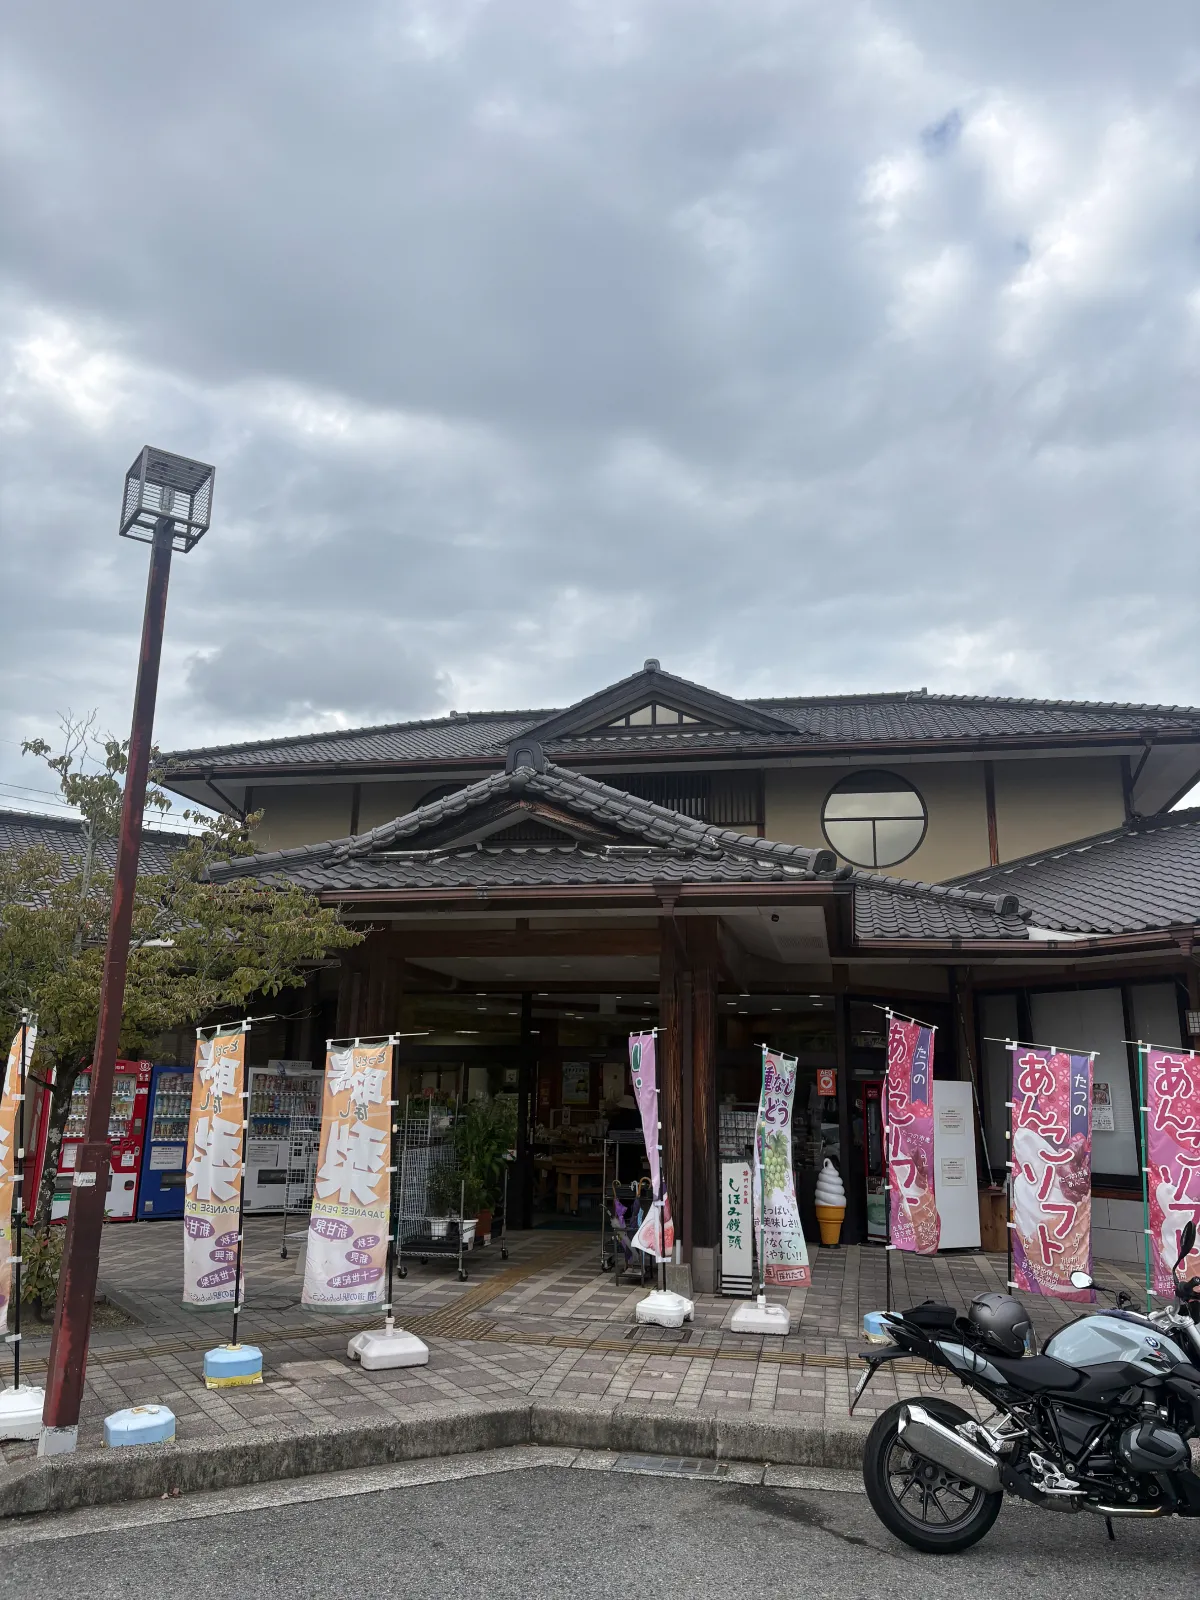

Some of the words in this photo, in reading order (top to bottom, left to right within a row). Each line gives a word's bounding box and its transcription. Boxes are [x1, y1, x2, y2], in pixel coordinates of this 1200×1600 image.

[913, 1045, 926, 1085] たつの
[760, 1097, 789, 1126] どう
[1074, 1073, 1087, 1117] たつの
[1018, 1053, 1077, 1266] あんこソフト
[726, 1178, 742, 1250] しほみ饅頭
